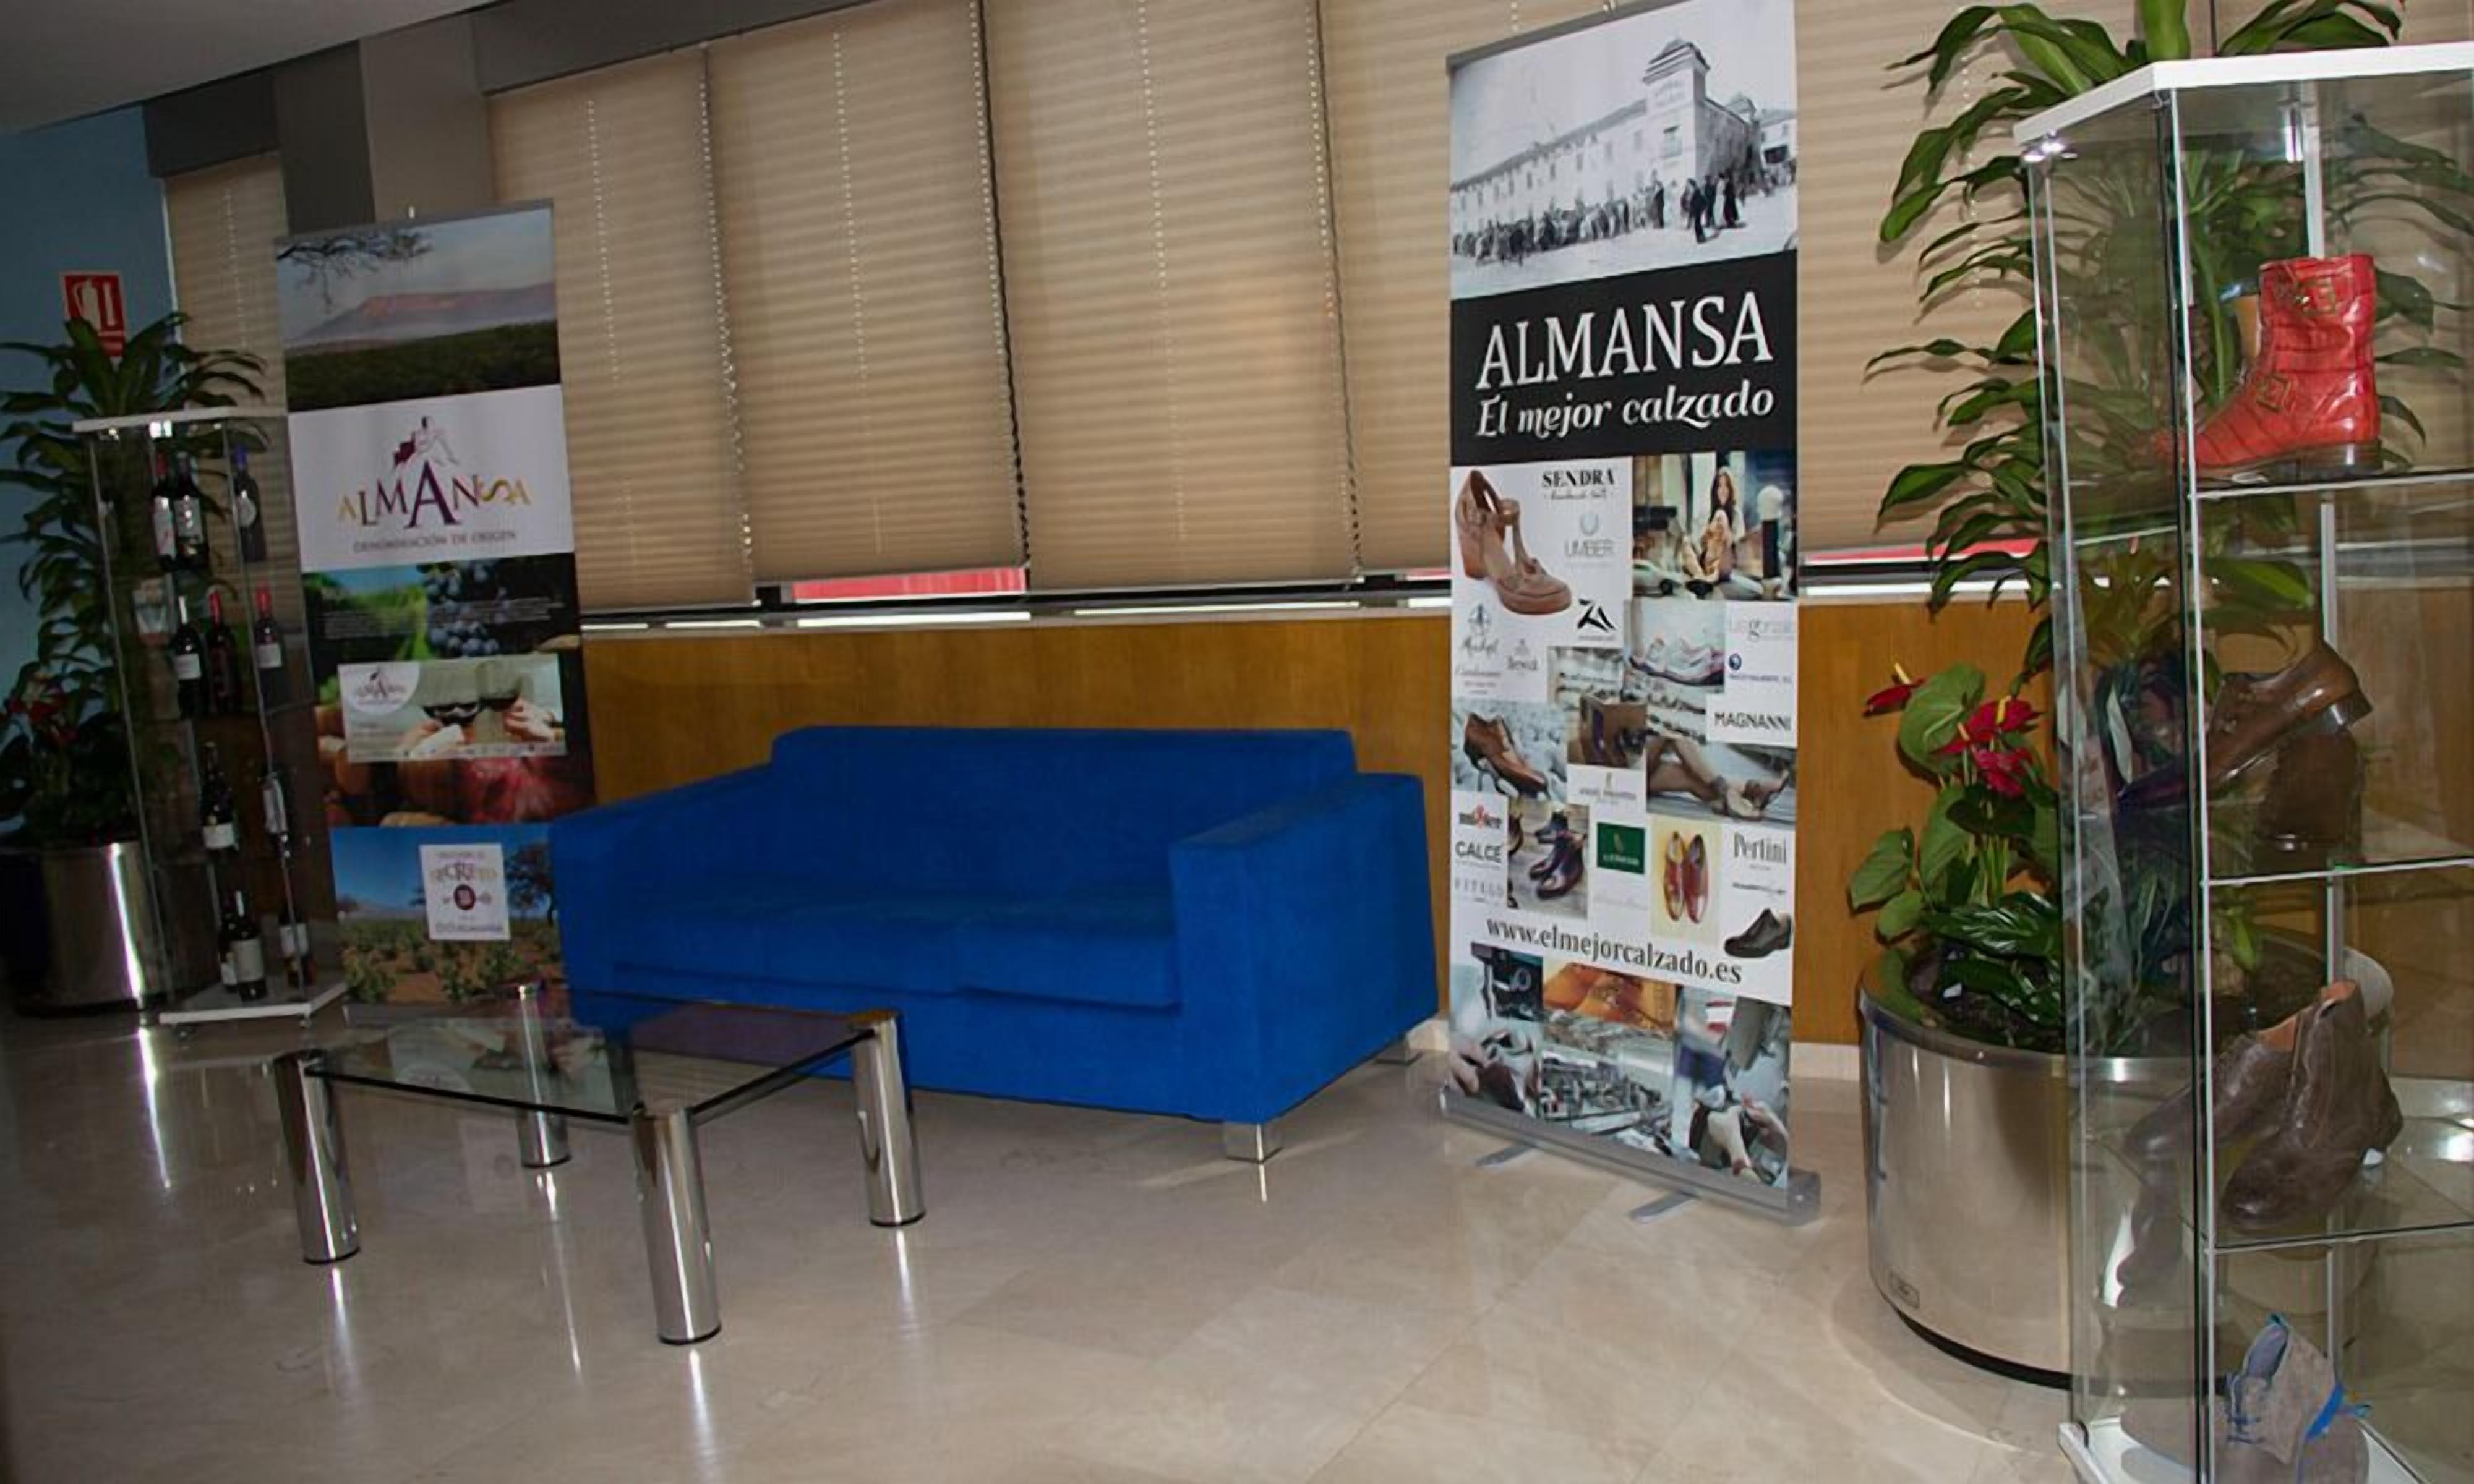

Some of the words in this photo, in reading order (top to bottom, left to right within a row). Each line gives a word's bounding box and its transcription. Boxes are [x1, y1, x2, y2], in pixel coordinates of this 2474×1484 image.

[1475, 291, 1773, 390] ALMANSA
[1476, 393, 1507, 437] El
[1518, 392, 1612, 438] mejor
[1622, 378, 1774, 429] calzado
[338, 460, 532, 529] ALMANSA
[1542, 468, 1615, 487] SENDRA
[1455, 840, 1502, 864] CALCE
[1486, 918, 1743, 984] www.elmejorcalzado.es
